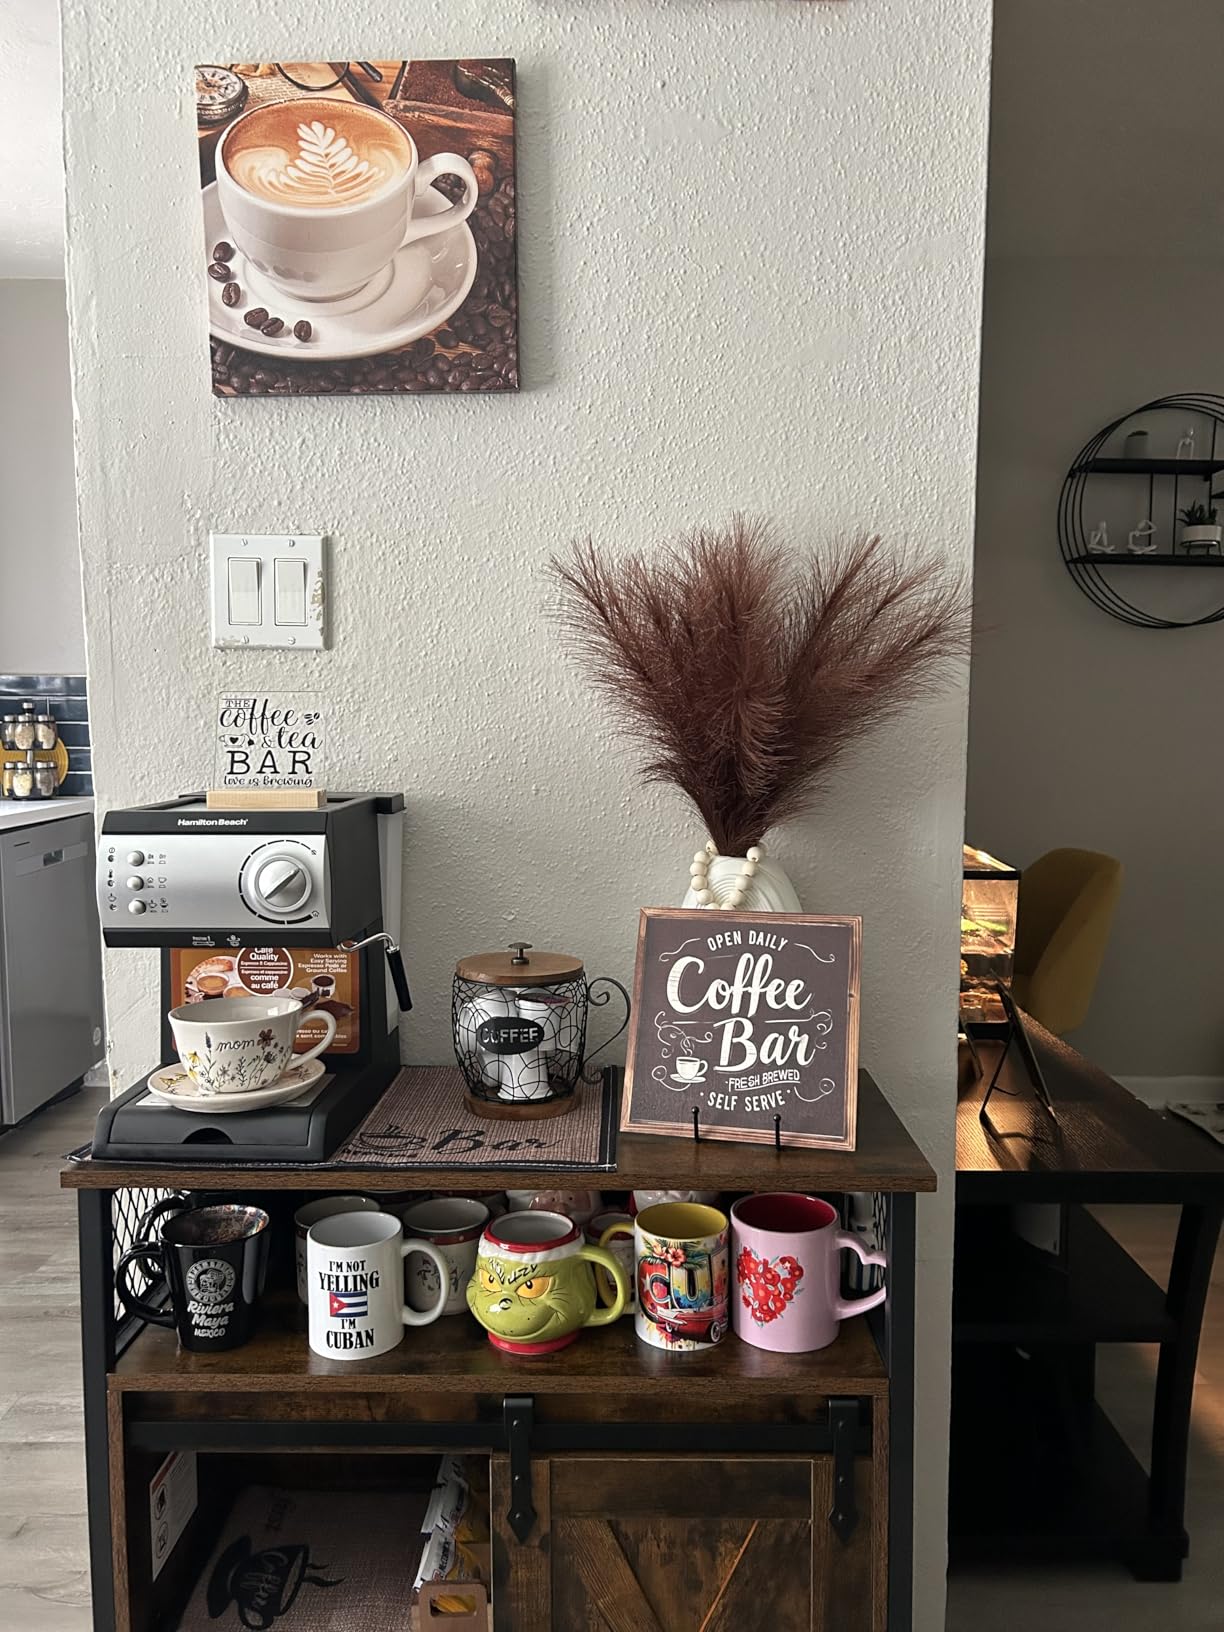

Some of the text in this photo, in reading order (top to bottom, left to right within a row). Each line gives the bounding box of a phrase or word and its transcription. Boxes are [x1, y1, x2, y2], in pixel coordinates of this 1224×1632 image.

[225, 700, 251, 708] THE
[220, 698, 299, 735] coffee
[261, 726, 323, 749] & tea
[226, 750, 313, 775] BAR
[224, 775, 313, 788] love is brewing
[177, 818, 248, 827] Hamilton Beach
[707, 930, 789, 951] OPEN DAILY
[249, 952, 279, 962] Quality
[261, 980, 279, 989] café
[666, 952, 814, 1018] Coffee
[481, 1026, 540, 1044] COFFEE
[216, 1039, 256, 1052] mom
[713, 1016, 816, 1073] Bar
[728, 1068, 801, 1092] FRESH BREWED
[707, 1090, 786, 1112] SELF SERVE
[433, 1128, 562, 1154] Bar
[328, 1259, 367, 1272] I'M NOT
[318, 1270, 381, 1293] YELLING
[187, 1300, 234, 1315] Riviera
[191, 1313, 230, 1329] Maya
[340, 1318, 357, 1330] I'M
[194, 1327, 226, 1338] MEXICO
[326, 1328, 375, 1351] CUBAN
